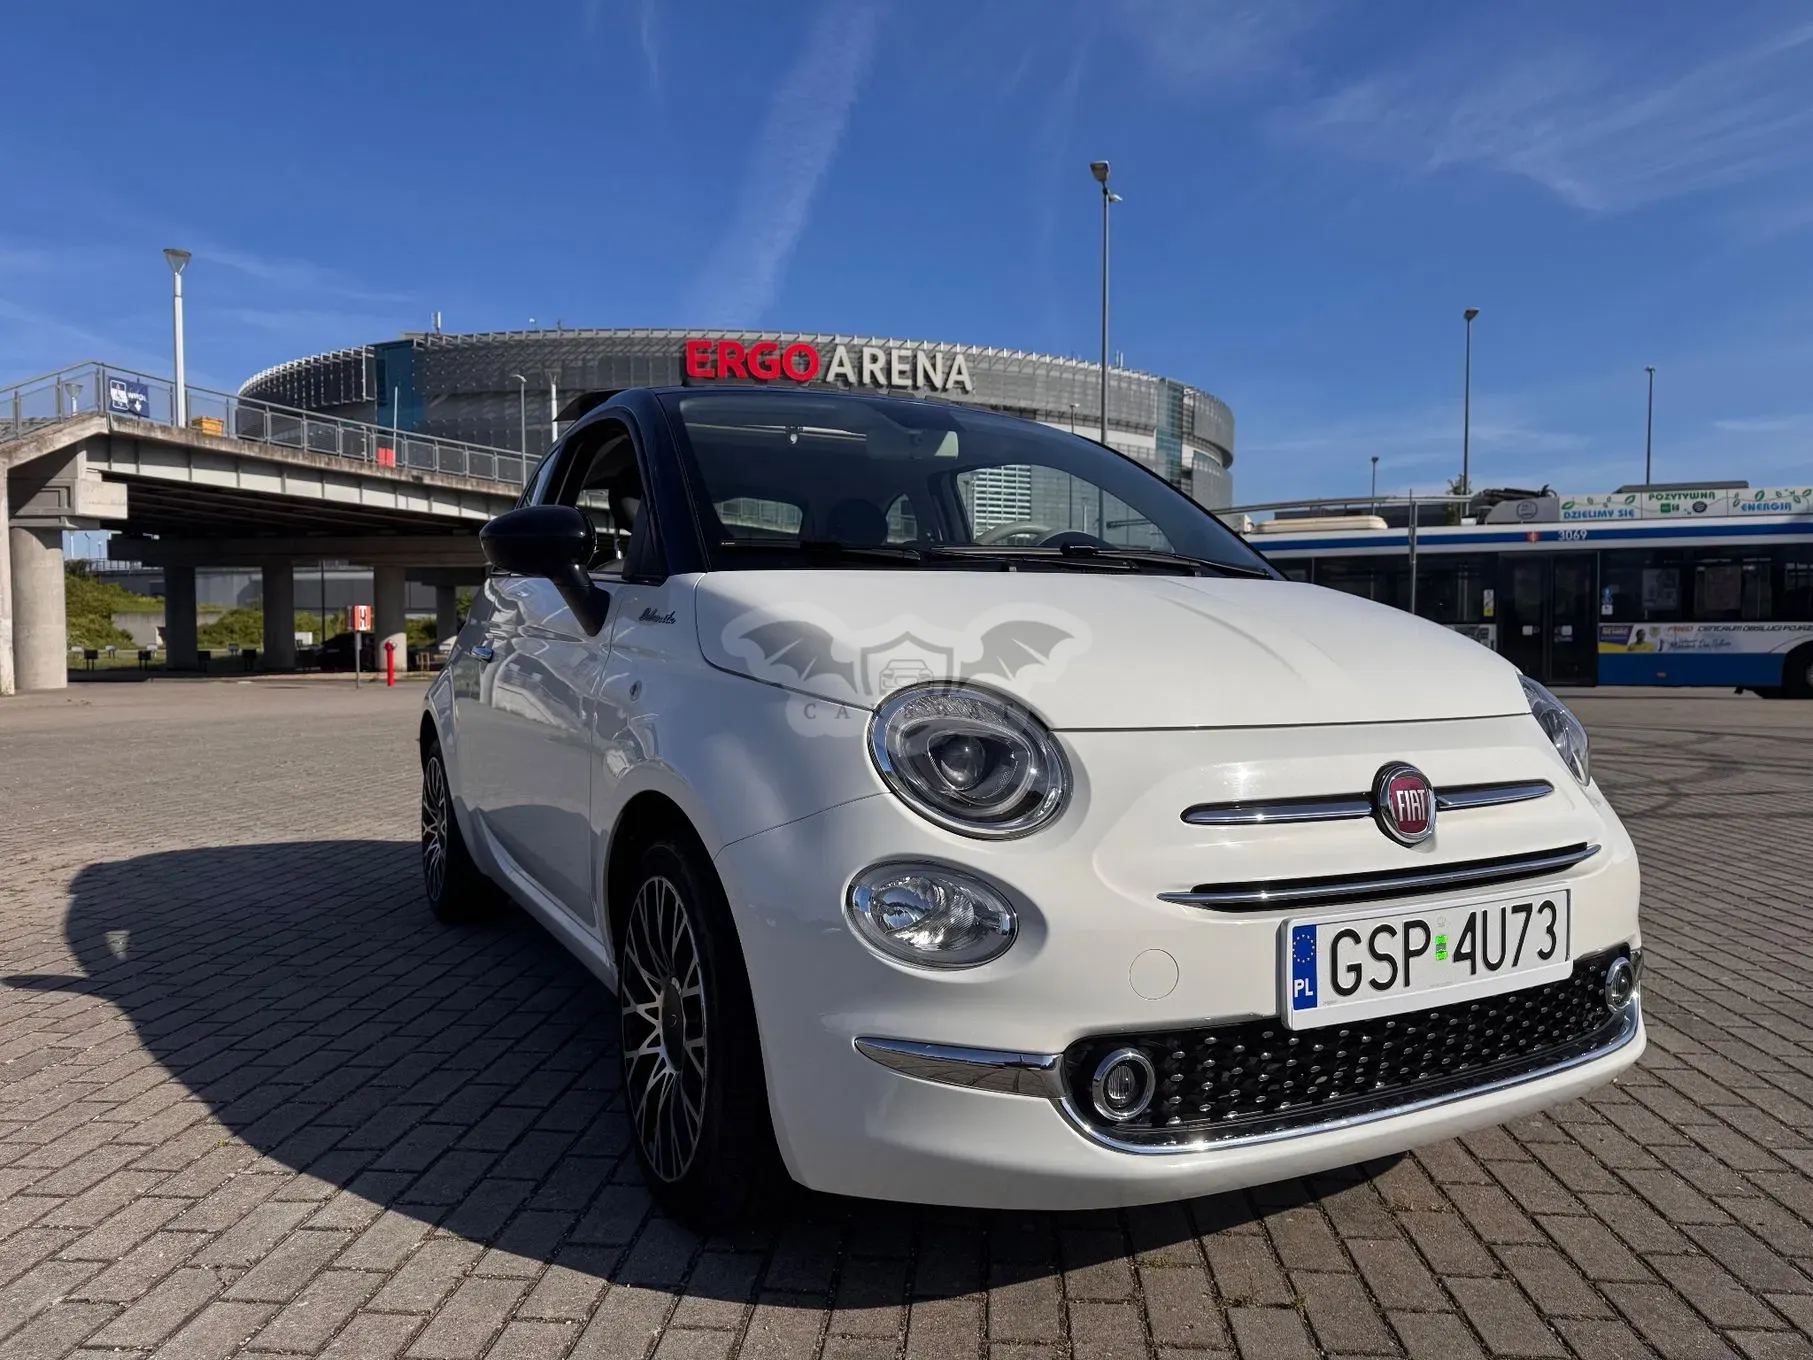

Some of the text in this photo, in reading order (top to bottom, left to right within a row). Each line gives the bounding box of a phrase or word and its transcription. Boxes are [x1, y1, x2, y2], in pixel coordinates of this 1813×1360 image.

[685, 339, 974, 392] ERGO ARENA
[1558, 530, 1588, 541] 3069
[1395, 789, 1426, 822] FIAT
[1330, 899, 1557, 997] GSP 4U73
[1293, 978, 1314, 998] PL
